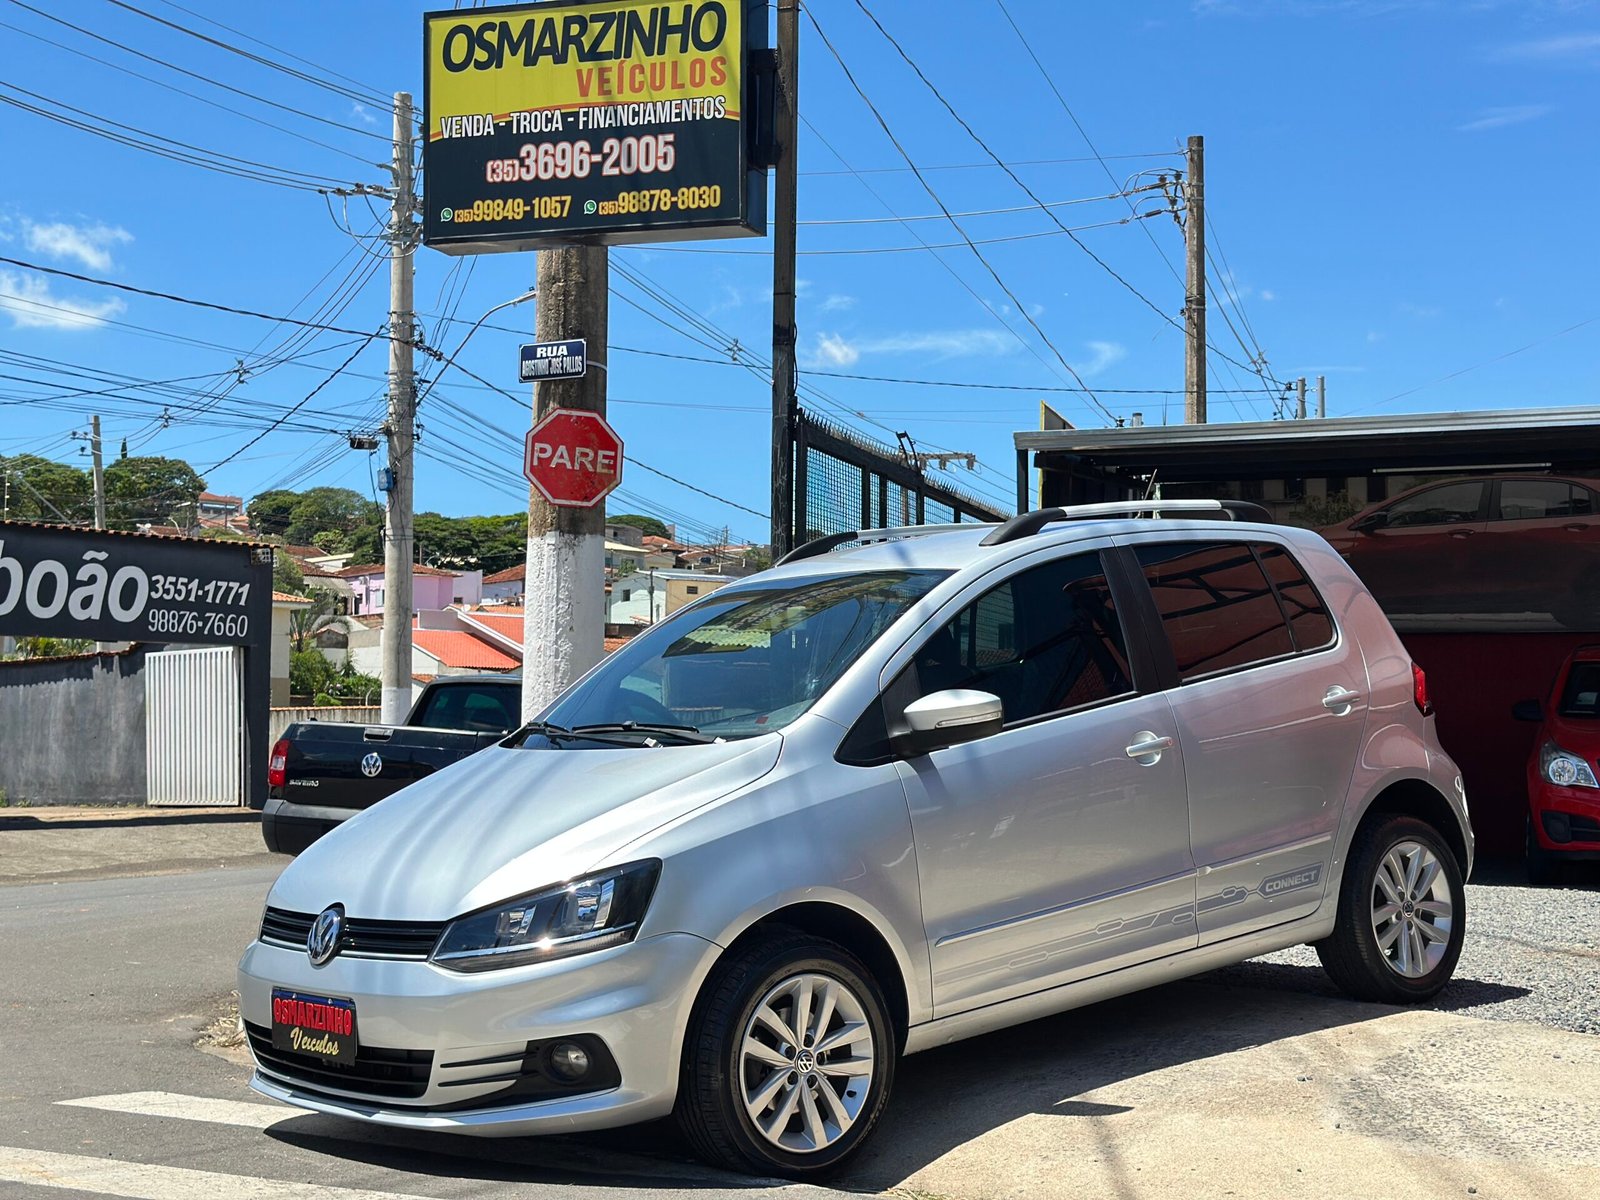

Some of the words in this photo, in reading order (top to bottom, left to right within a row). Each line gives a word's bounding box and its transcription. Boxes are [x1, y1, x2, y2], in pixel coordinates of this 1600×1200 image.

[442, 1, 727, 72] OSMARZINHO
[576, 56, 727, 97] VEÍCULOS
[440, 114, 495, 138] VENDA
[510, 109, 563, 134] TROCA
[578, 96, 726, 130] FINANCIAMENTOS
[485, 133, 675, 183] (35)3696-2005
[454, 195, 572, 223] (35)99849-1057
[598, 185, 721, 215] (35)98878-8030
[536, 345, 568, 358] RUA
[532, 442, 616, 475] PARE
[150, 574, 250, 606] 3551-1771
[148, 609, 248, 638] 98876-7660
[1265, 870, 1317, 892] CONNECT
[273, 998, 352, 1036] OSMARZINHO
